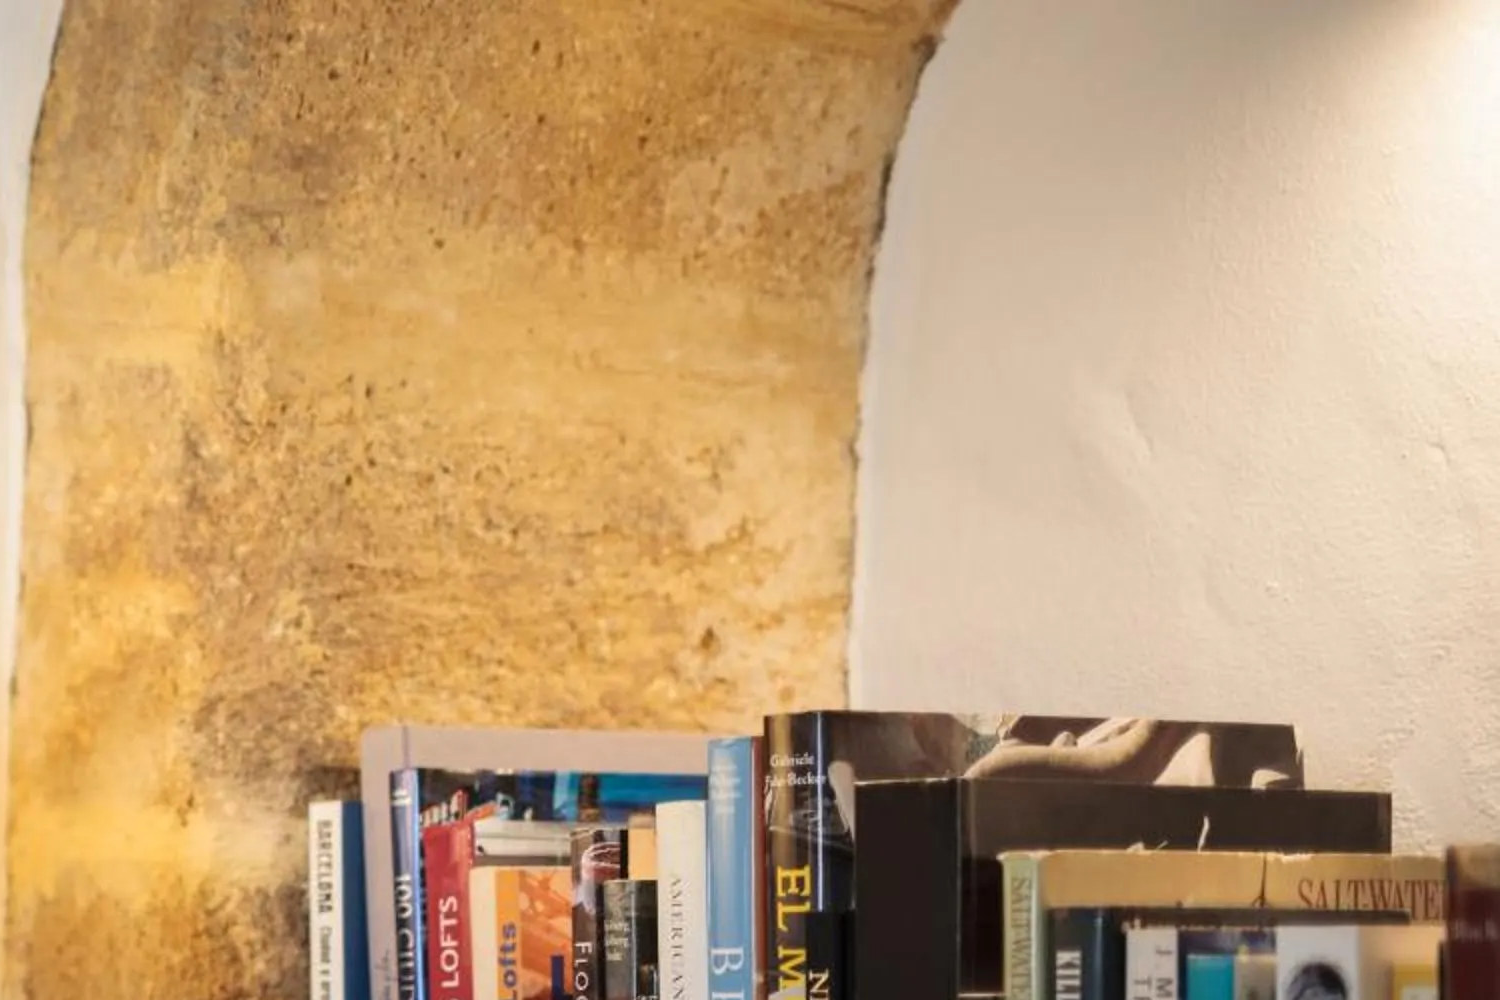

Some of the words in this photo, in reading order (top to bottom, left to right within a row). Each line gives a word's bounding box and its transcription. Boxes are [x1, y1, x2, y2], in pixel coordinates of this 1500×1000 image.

[395, 873, 413, 918] 100
[775, 864, 812, 932] EL
[1297, 879, 1446, 922] SALT-WATE
[439, 895, 460, 989] LOFTS
[668, 873, 686, 1000] AMERICAN
